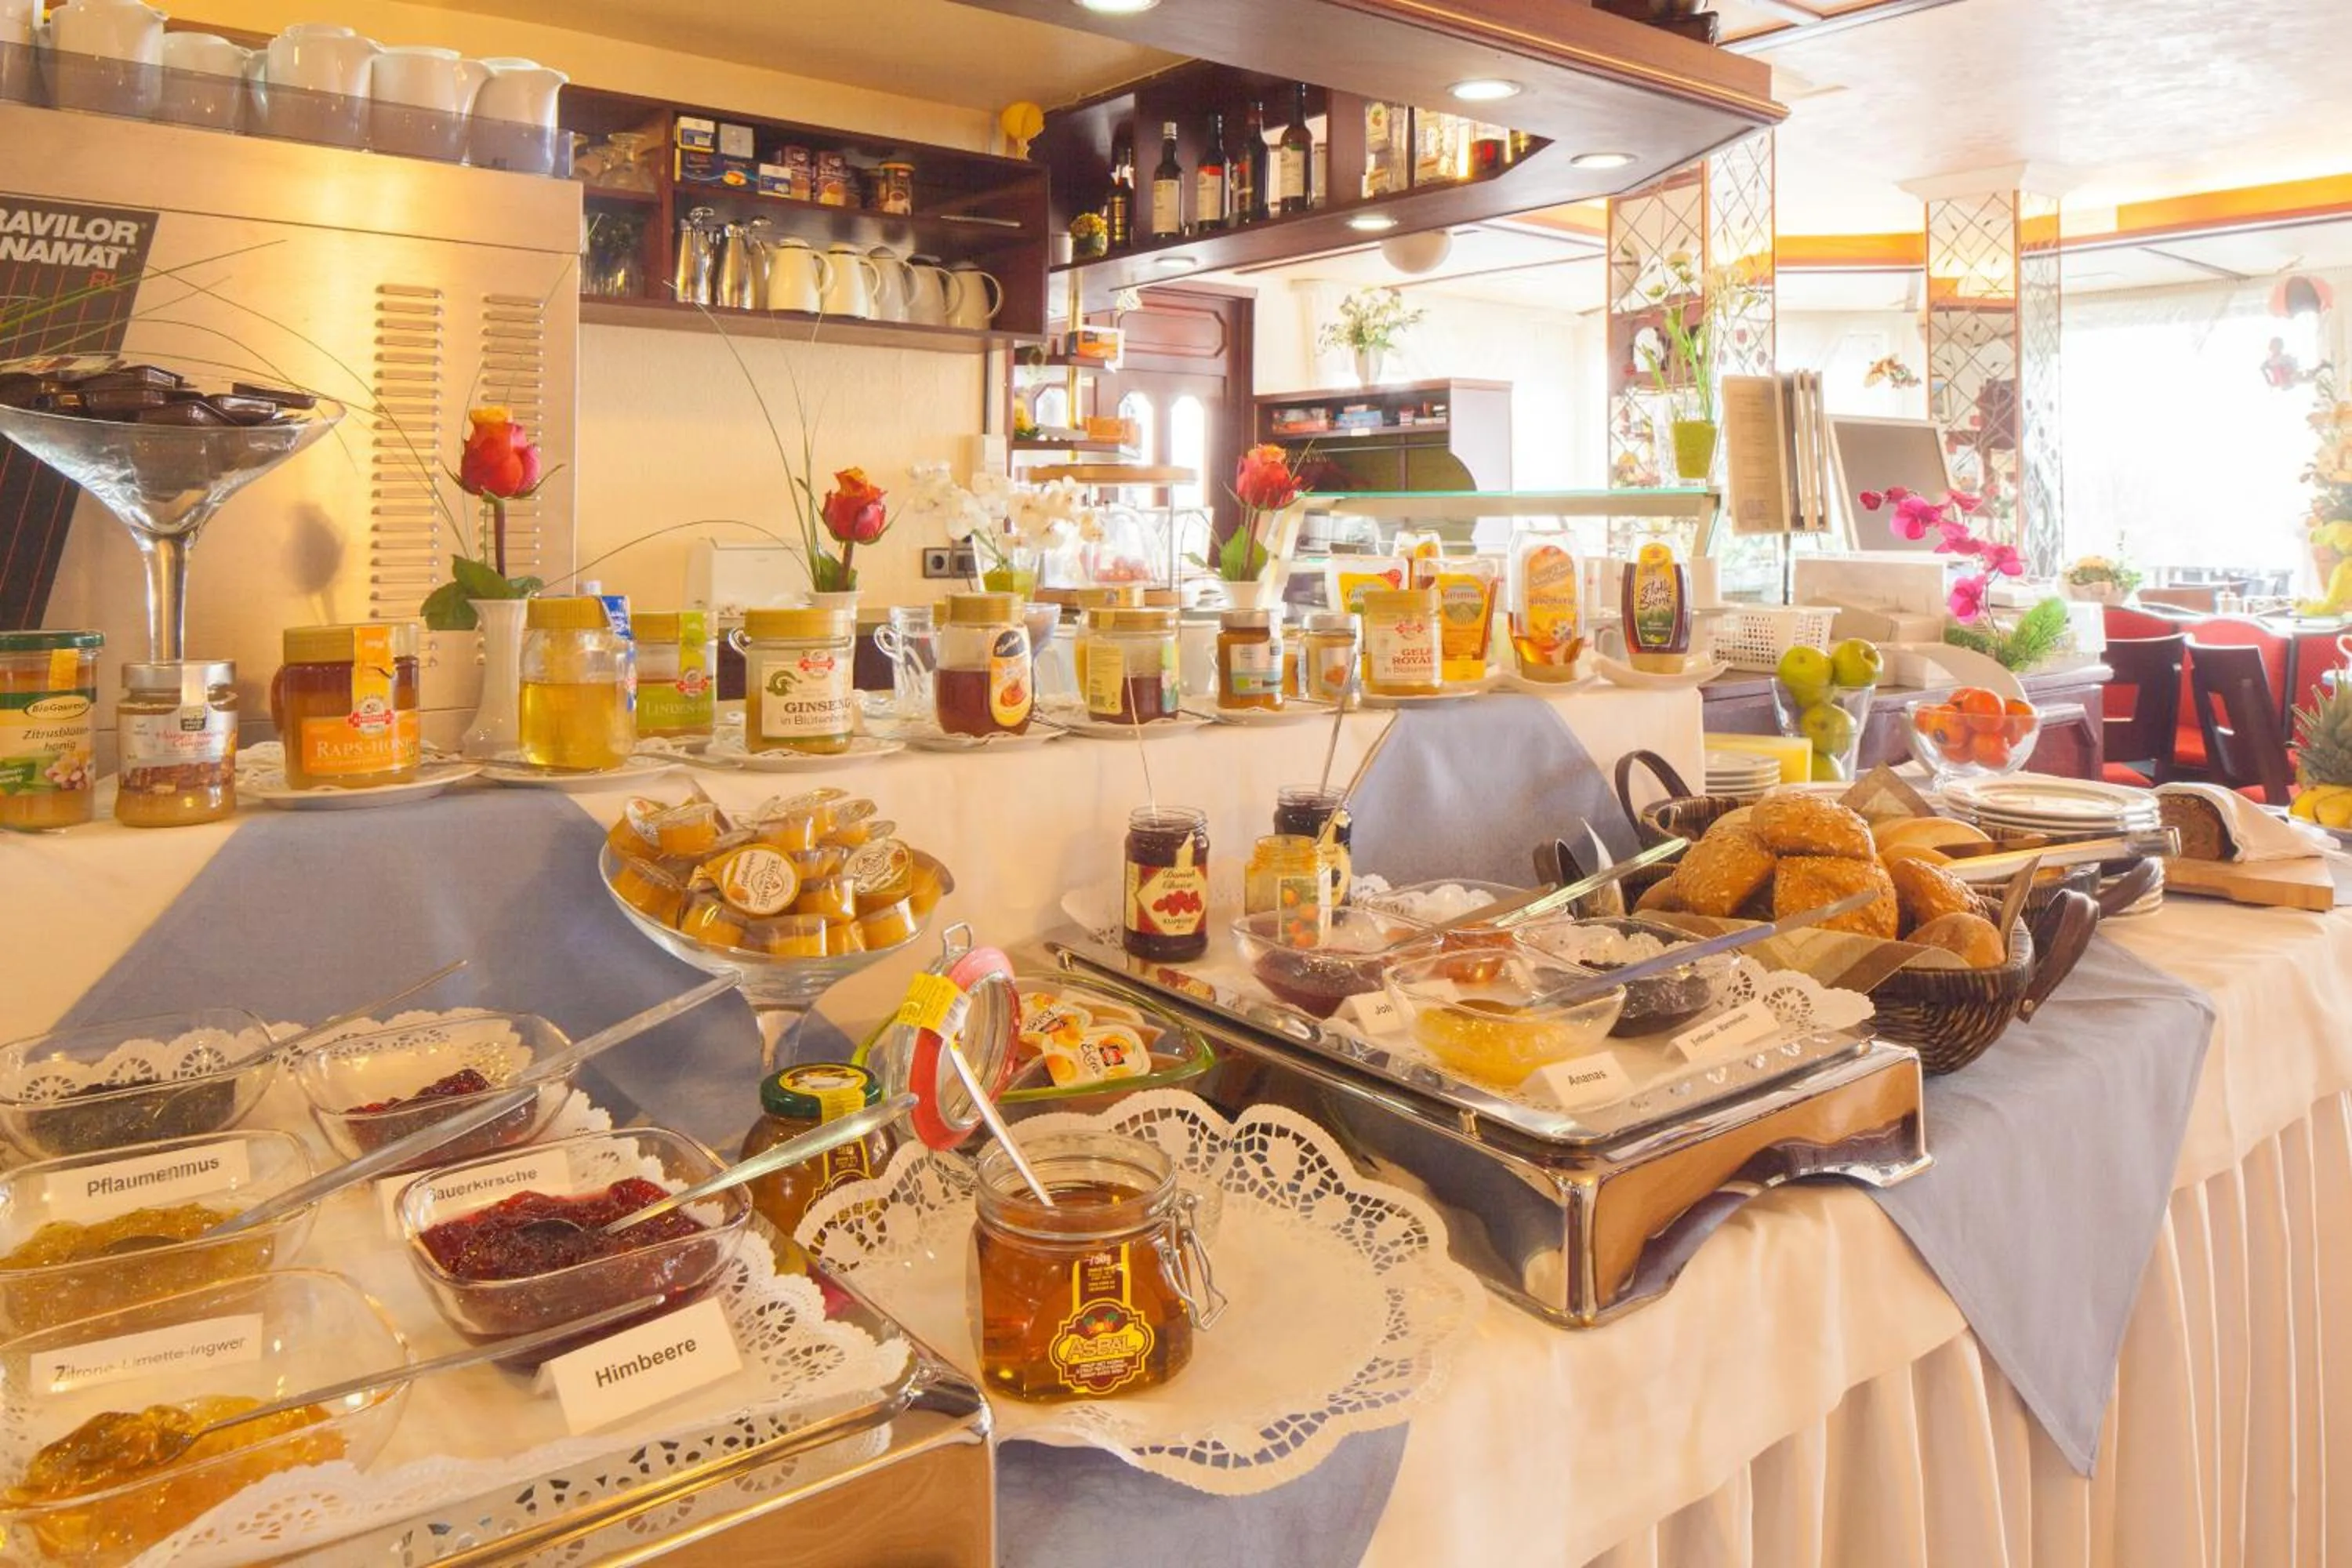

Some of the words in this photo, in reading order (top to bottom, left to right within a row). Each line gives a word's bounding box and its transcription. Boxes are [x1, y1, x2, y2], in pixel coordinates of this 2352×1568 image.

[0, 236, 128, 270] NAMAT
[1567, 1070, 1607, 1086] Ananas
[87, 1157, 220, 1196] Pflaumenmus
[595, 1338, 697, 1388] Himbeere
